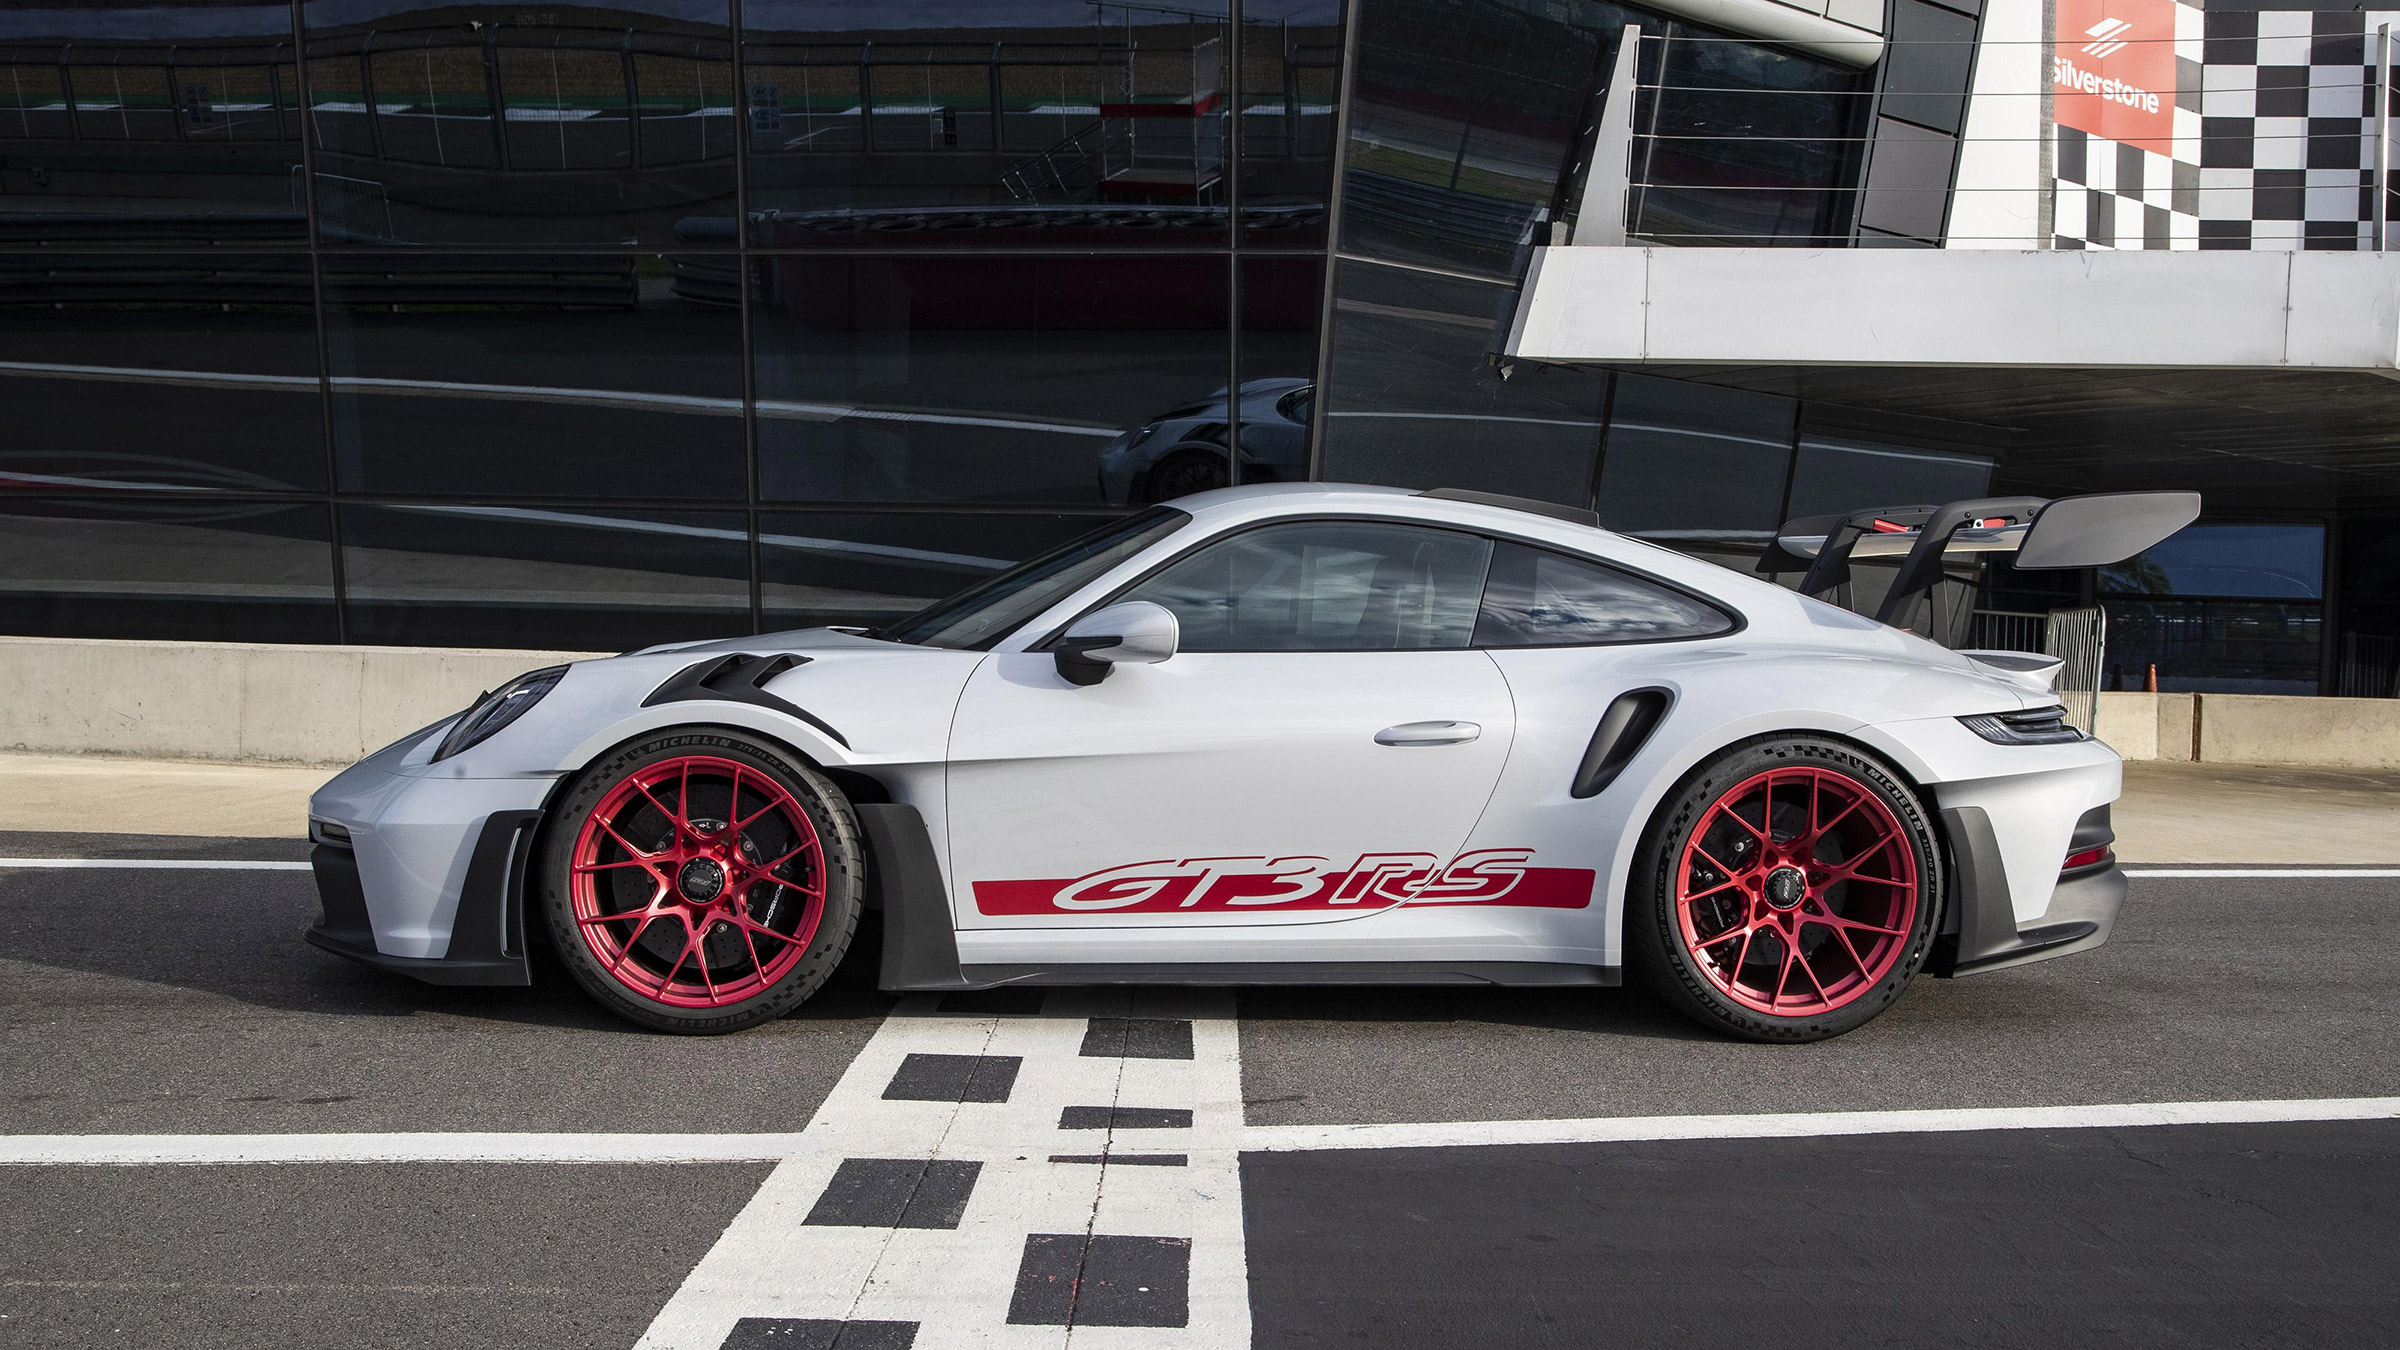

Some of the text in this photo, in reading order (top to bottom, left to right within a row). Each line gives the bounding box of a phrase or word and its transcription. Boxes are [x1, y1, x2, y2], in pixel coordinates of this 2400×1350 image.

[648, 736, 731, 752] MICHELIN
[1867, 768, 1924, 831] MICHELIN
[1658, 872, 1666, 889] CUP
[1657, 892, 1666, 922] SPORT
[1669, 954, 1729, 1017] MICHELIN
[665, 1012, 749, 1028] MICHELIN
